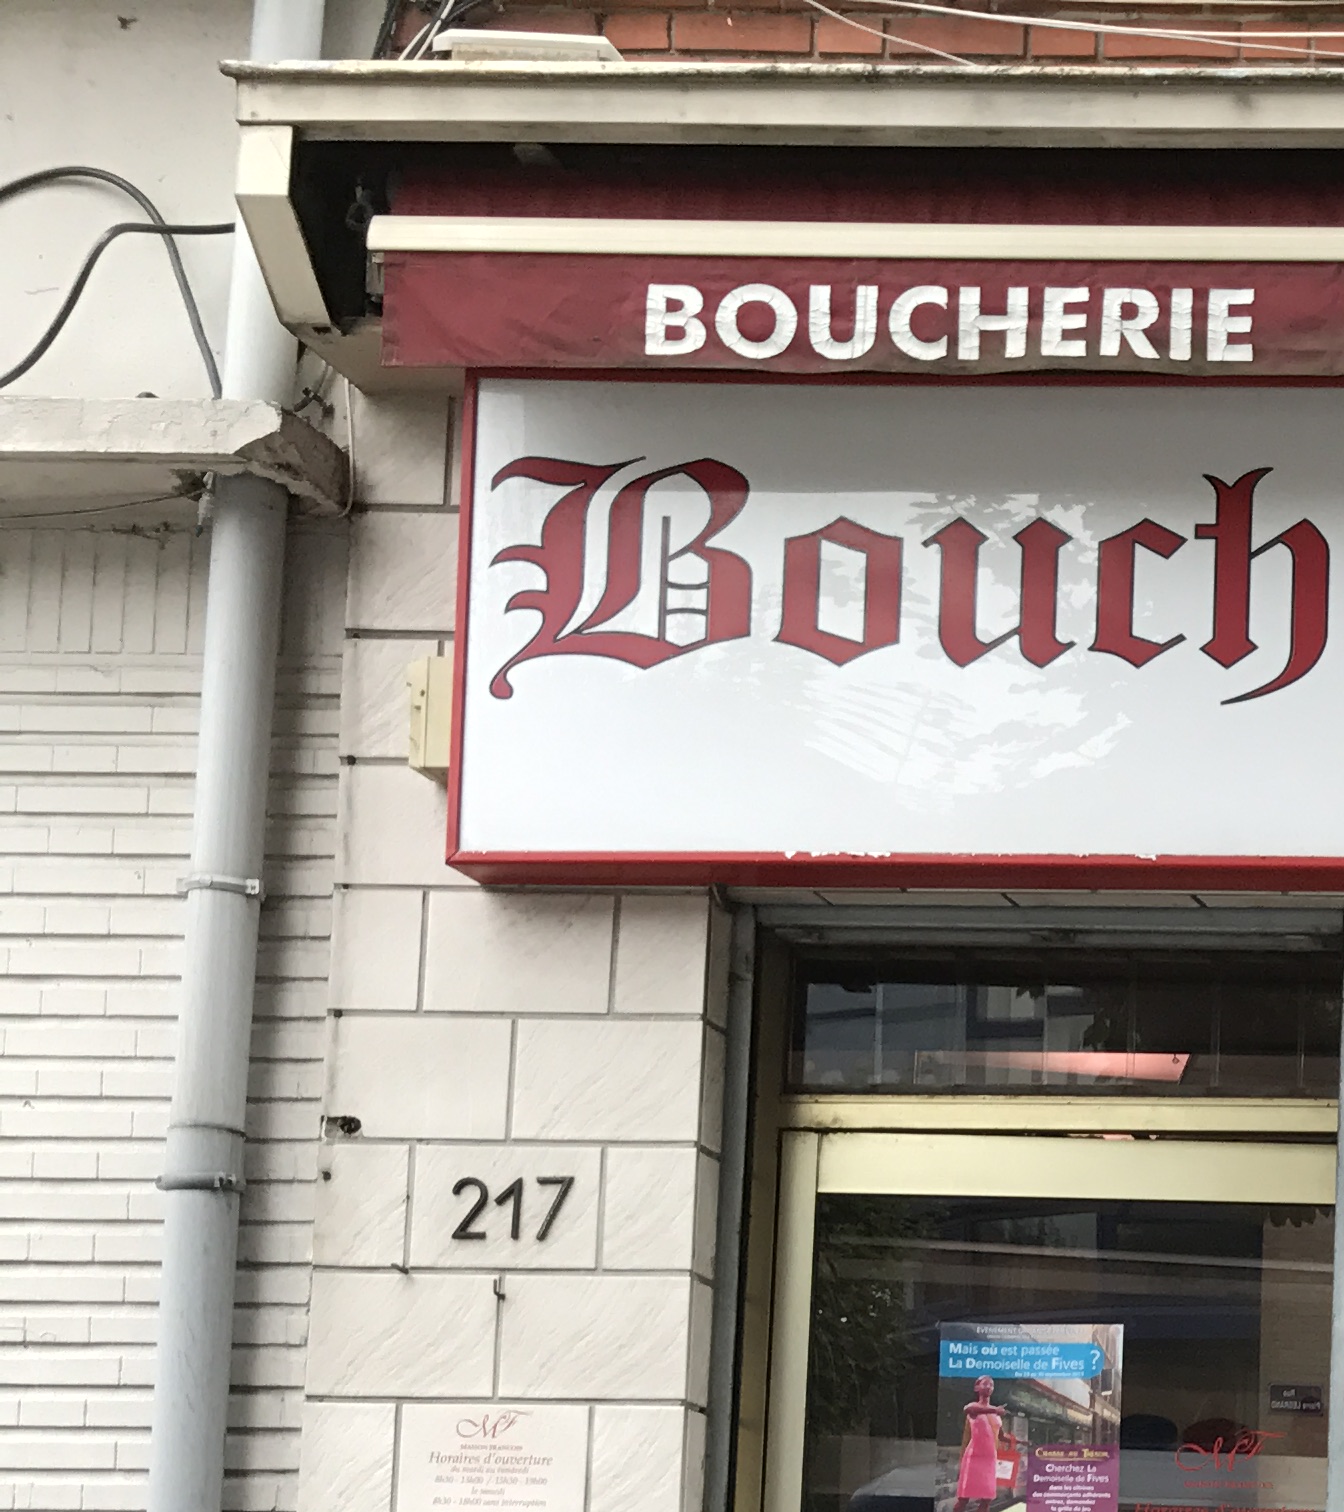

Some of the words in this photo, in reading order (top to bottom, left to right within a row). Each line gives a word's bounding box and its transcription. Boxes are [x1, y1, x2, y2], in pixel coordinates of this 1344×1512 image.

[643, 282, 1255, 363] BOUCHERIE
[452, 1176, 575, 1241] 217
[949, 1342, 978, 1355] Mais
[981, 1342, 998, 1355] où
[1001, 1345, 1018, 1355] est
[1020, 1343, 1060, 1357] passée
[948, 1357, 962, 1369] La
[965, 1357, 1031, 1371] Demoiselle
[1033, 1358, 1048, 1371] de
[1052, 1357, 1085, 1371] Fives
[428, 1451, 480, 1464] Horaires
[484, 1452, 553, 1466] d'ouverture
[1045, 1463, 1084, 1473] Cherchez
[1087, 1464, 1097, 1473] La
[1033, 1474, 1074, 1483] Demoiselle
[1075, 1475, 1085, 1483] de
[1087, 1474, 1109, 1483] Fives
